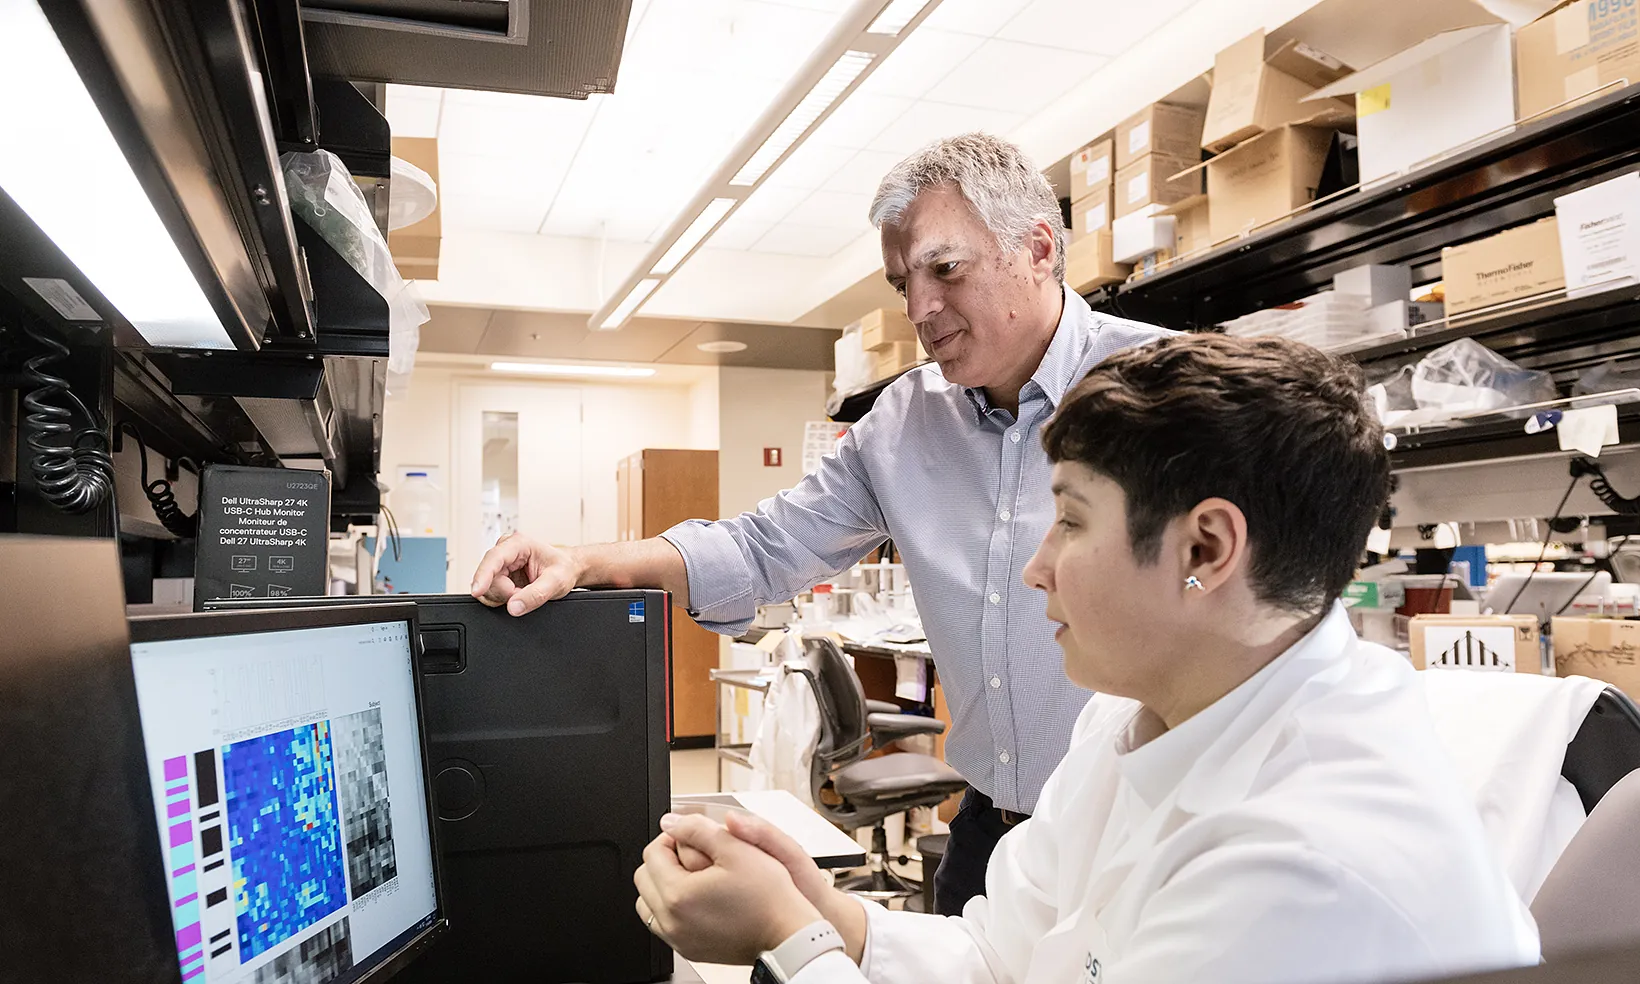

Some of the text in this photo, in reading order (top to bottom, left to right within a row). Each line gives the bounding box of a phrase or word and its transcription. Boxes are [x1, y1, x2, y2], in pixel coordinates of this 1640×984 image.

[286, 482, 318, 490] U2723QE
[221, 496, 238, 505] Dell
[239, 497, 283, 507] UltraSharp
[296, 499, 308, 507] 4K
[223, 507, 252, 515] USB-C
[254, 508, 272, 516] Hub
[238, 517, 275, 526] Moniteur
[219, 528, 308, 536] concentrateur USB-C
[220, 537, 236, 545] Dell
[249, 538, 294, 548] UltraSharp
